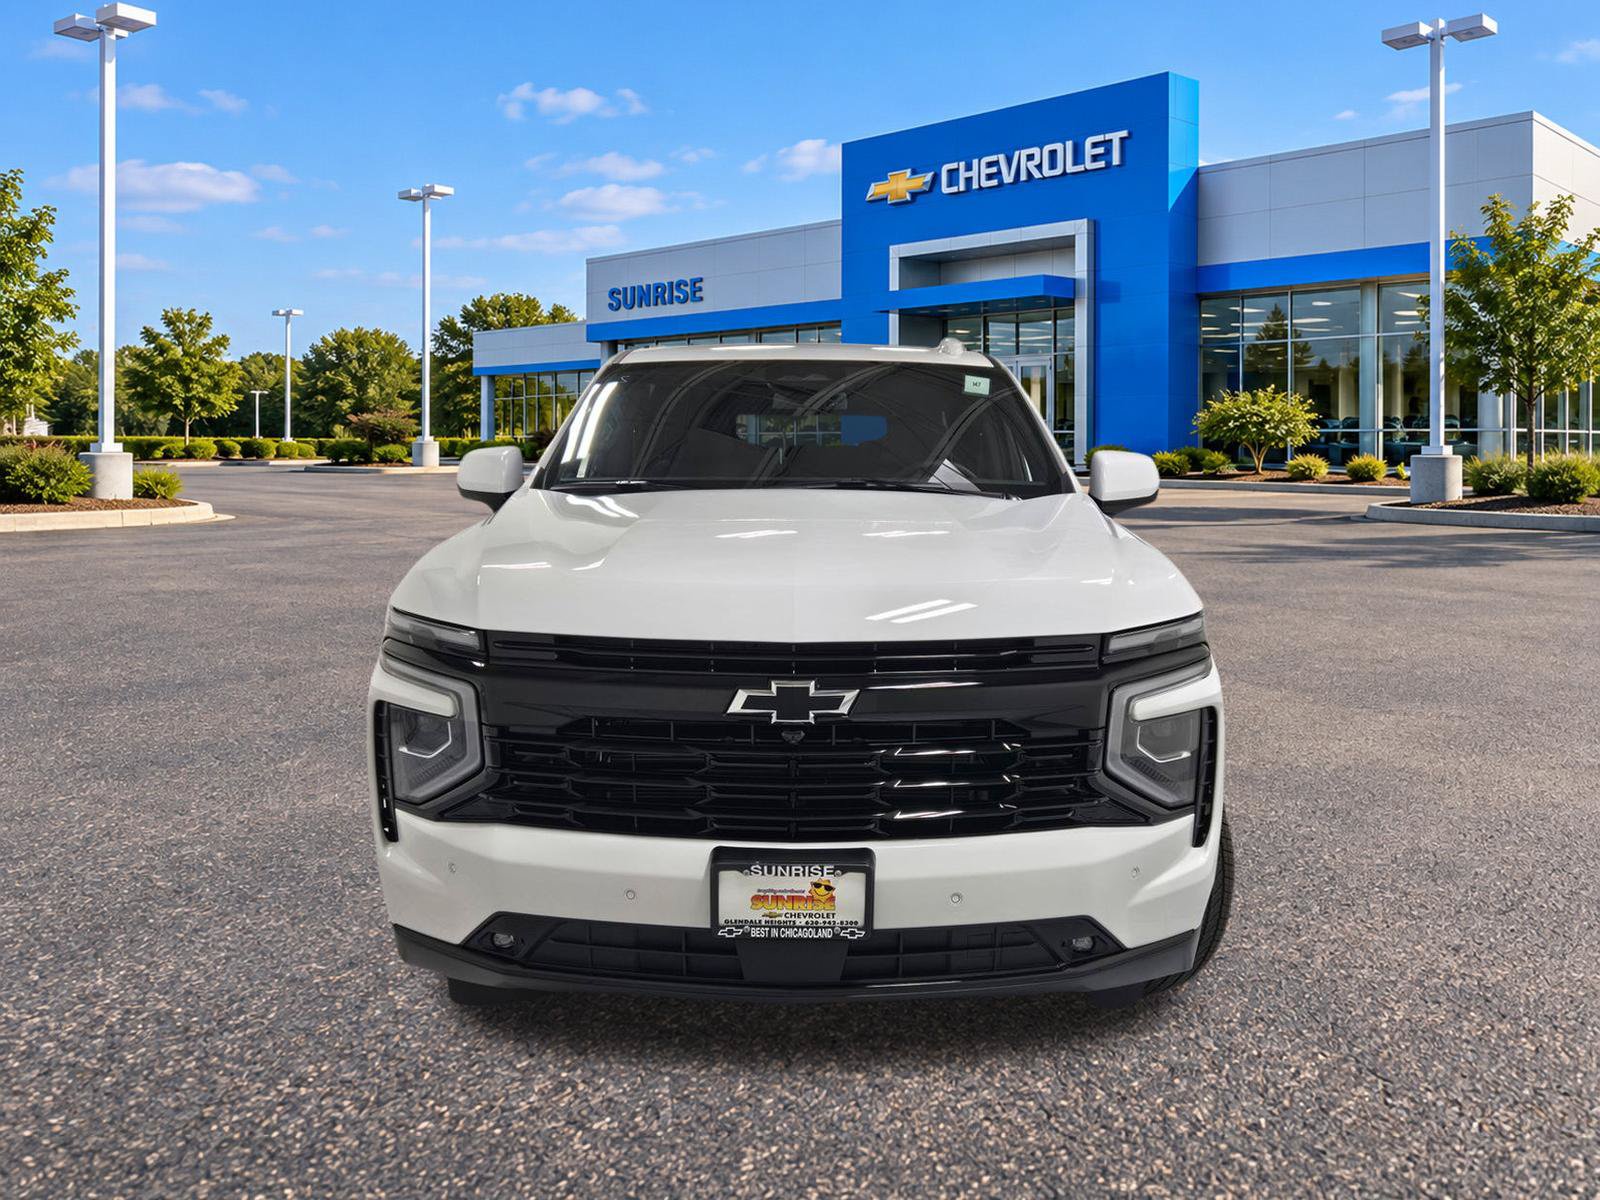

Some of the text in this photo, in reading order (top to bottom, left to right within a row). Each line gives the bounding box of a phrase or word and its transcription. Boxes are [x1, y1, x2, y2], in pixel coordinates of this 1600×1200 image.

[940, 130, 1129, 194] CHEVROLET
[608, 277, 704, 312] SUNRISE
[750, 865, 834, 877] SUNRISE
[750, 894, 836, 911] SUNRISE
[750, 927, 833, 938] BEST IN CHICAGOLAND
